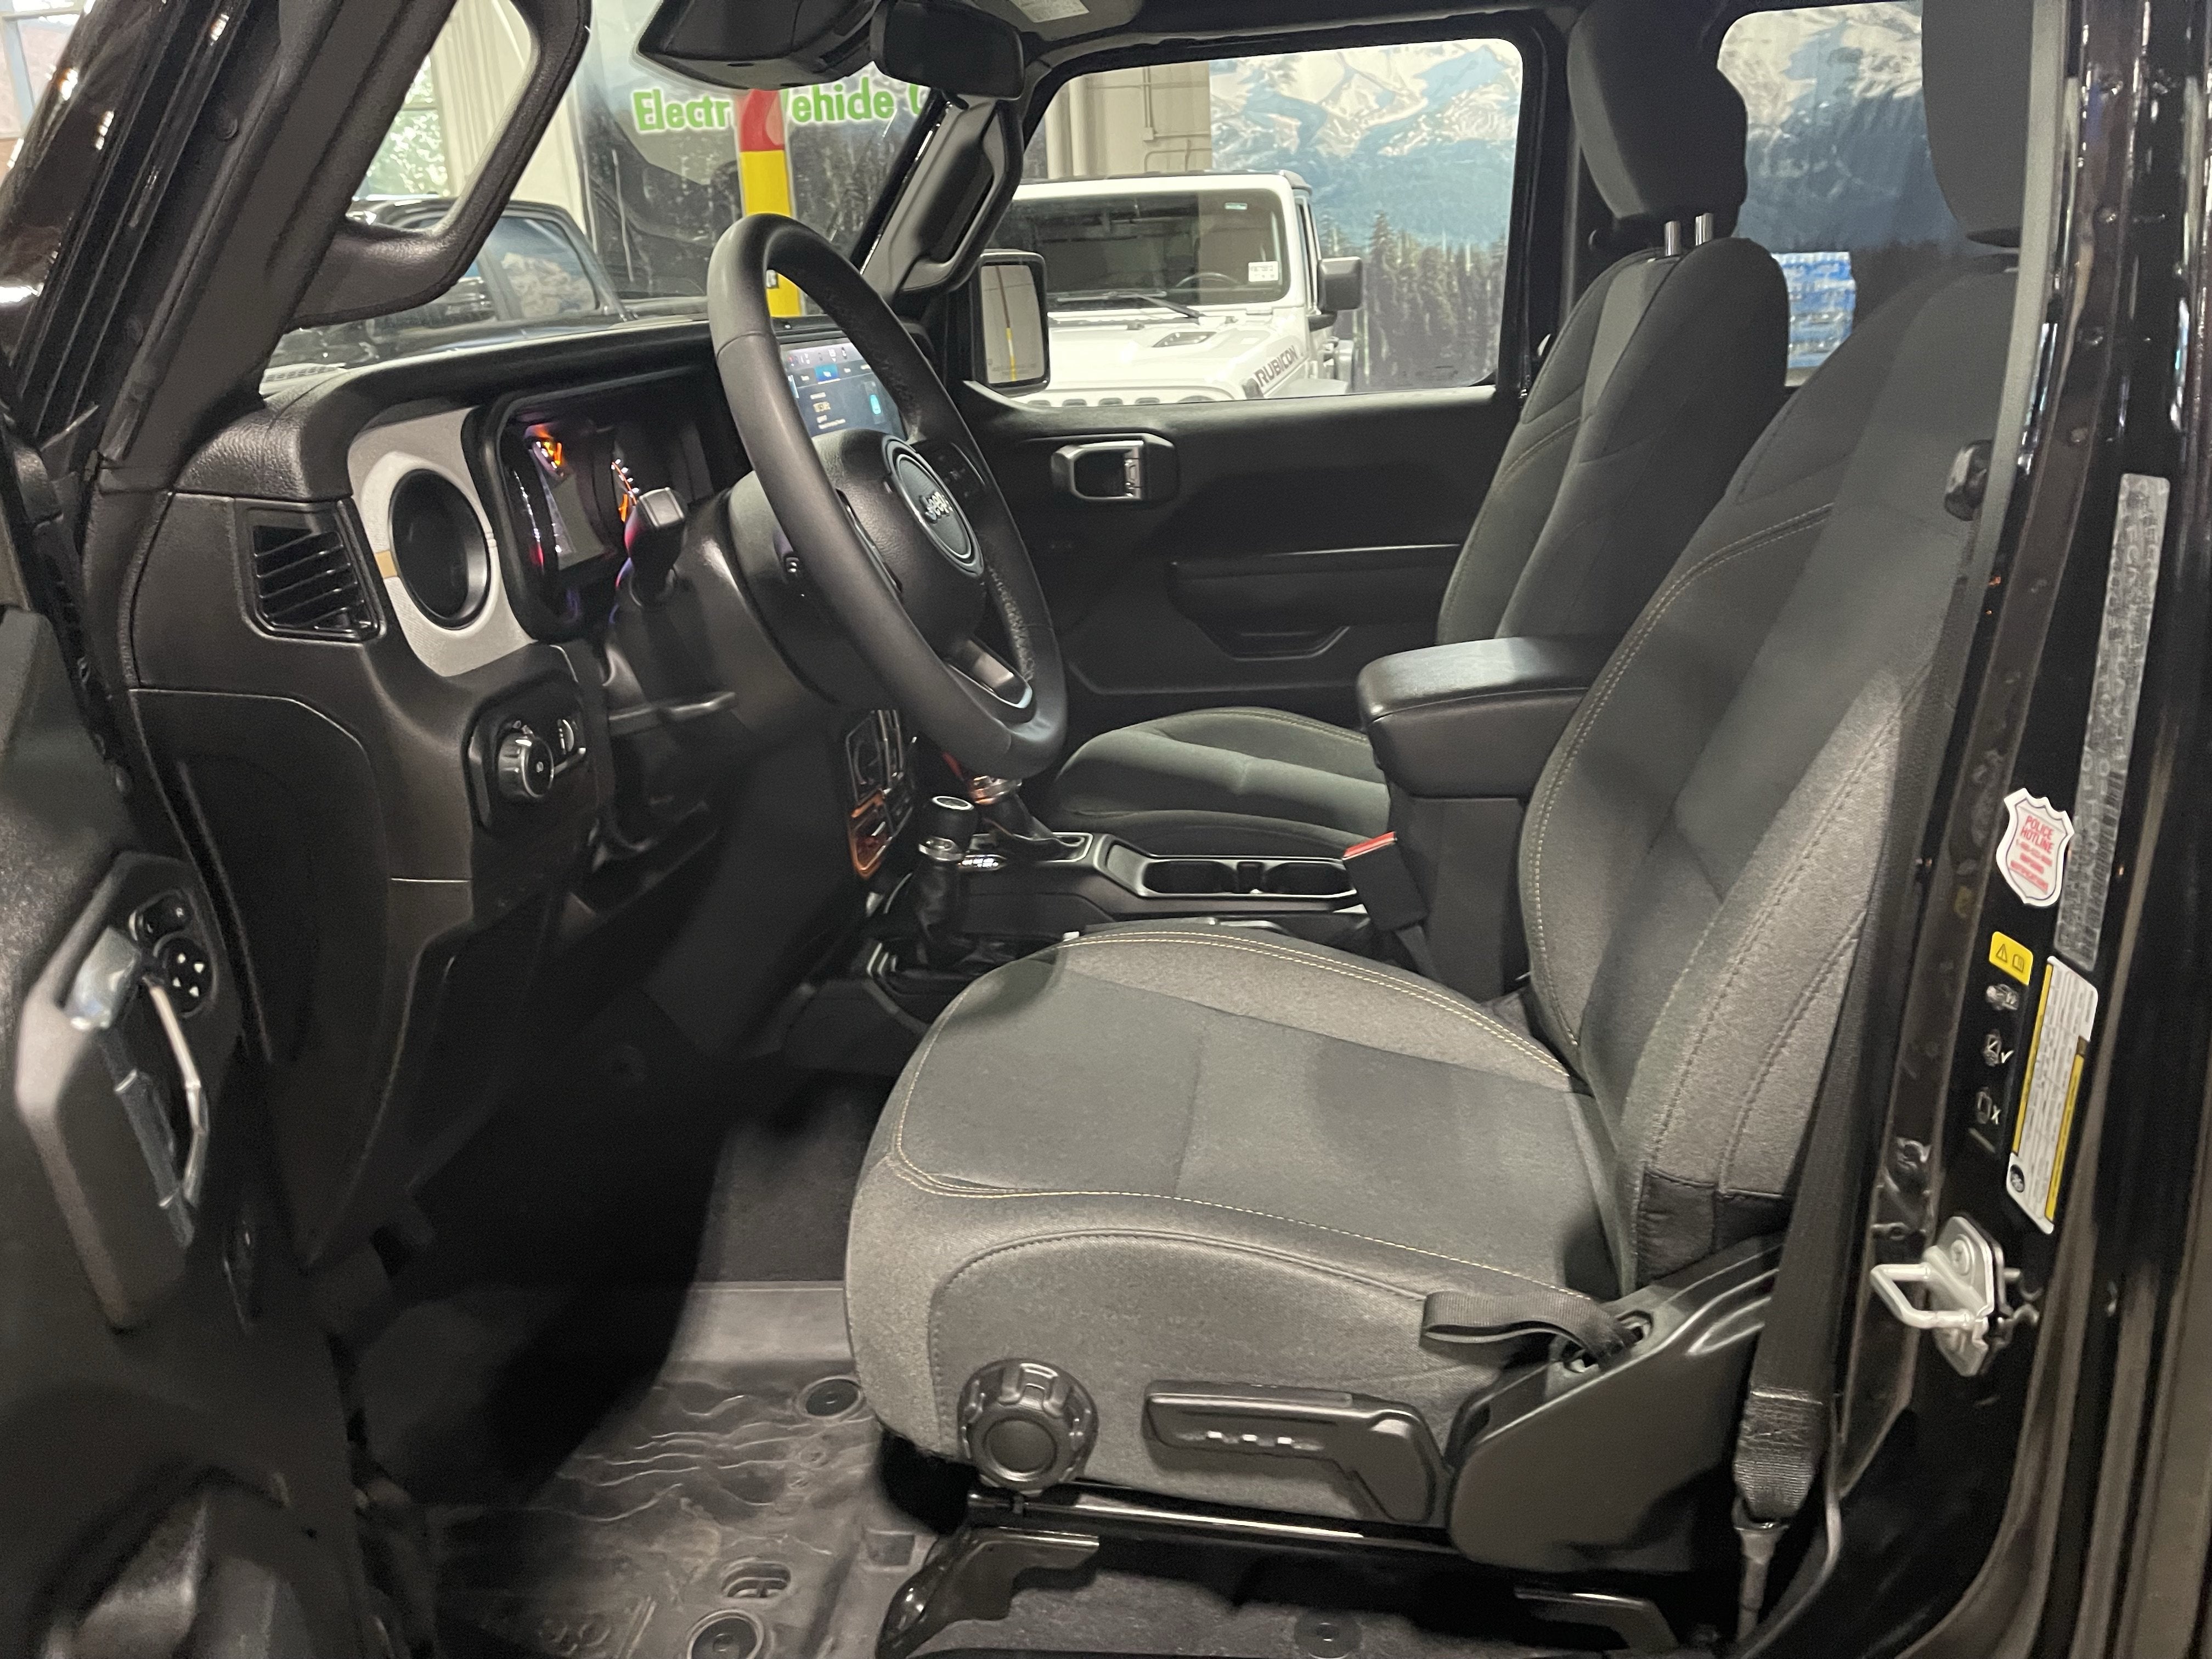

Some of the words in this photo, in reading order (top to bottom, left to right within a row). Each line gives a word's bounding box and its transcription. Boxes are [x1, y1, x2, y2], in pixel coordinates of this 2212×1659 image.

[632, 88, 731, 132] Electr
[1254, 345, 1298, 387] RUBICON
[922, 491, 953, 521] Jeep
[2021, 826, 2053, 854] HOTLINE
[2025, 815, 2053, 839] POLICE
